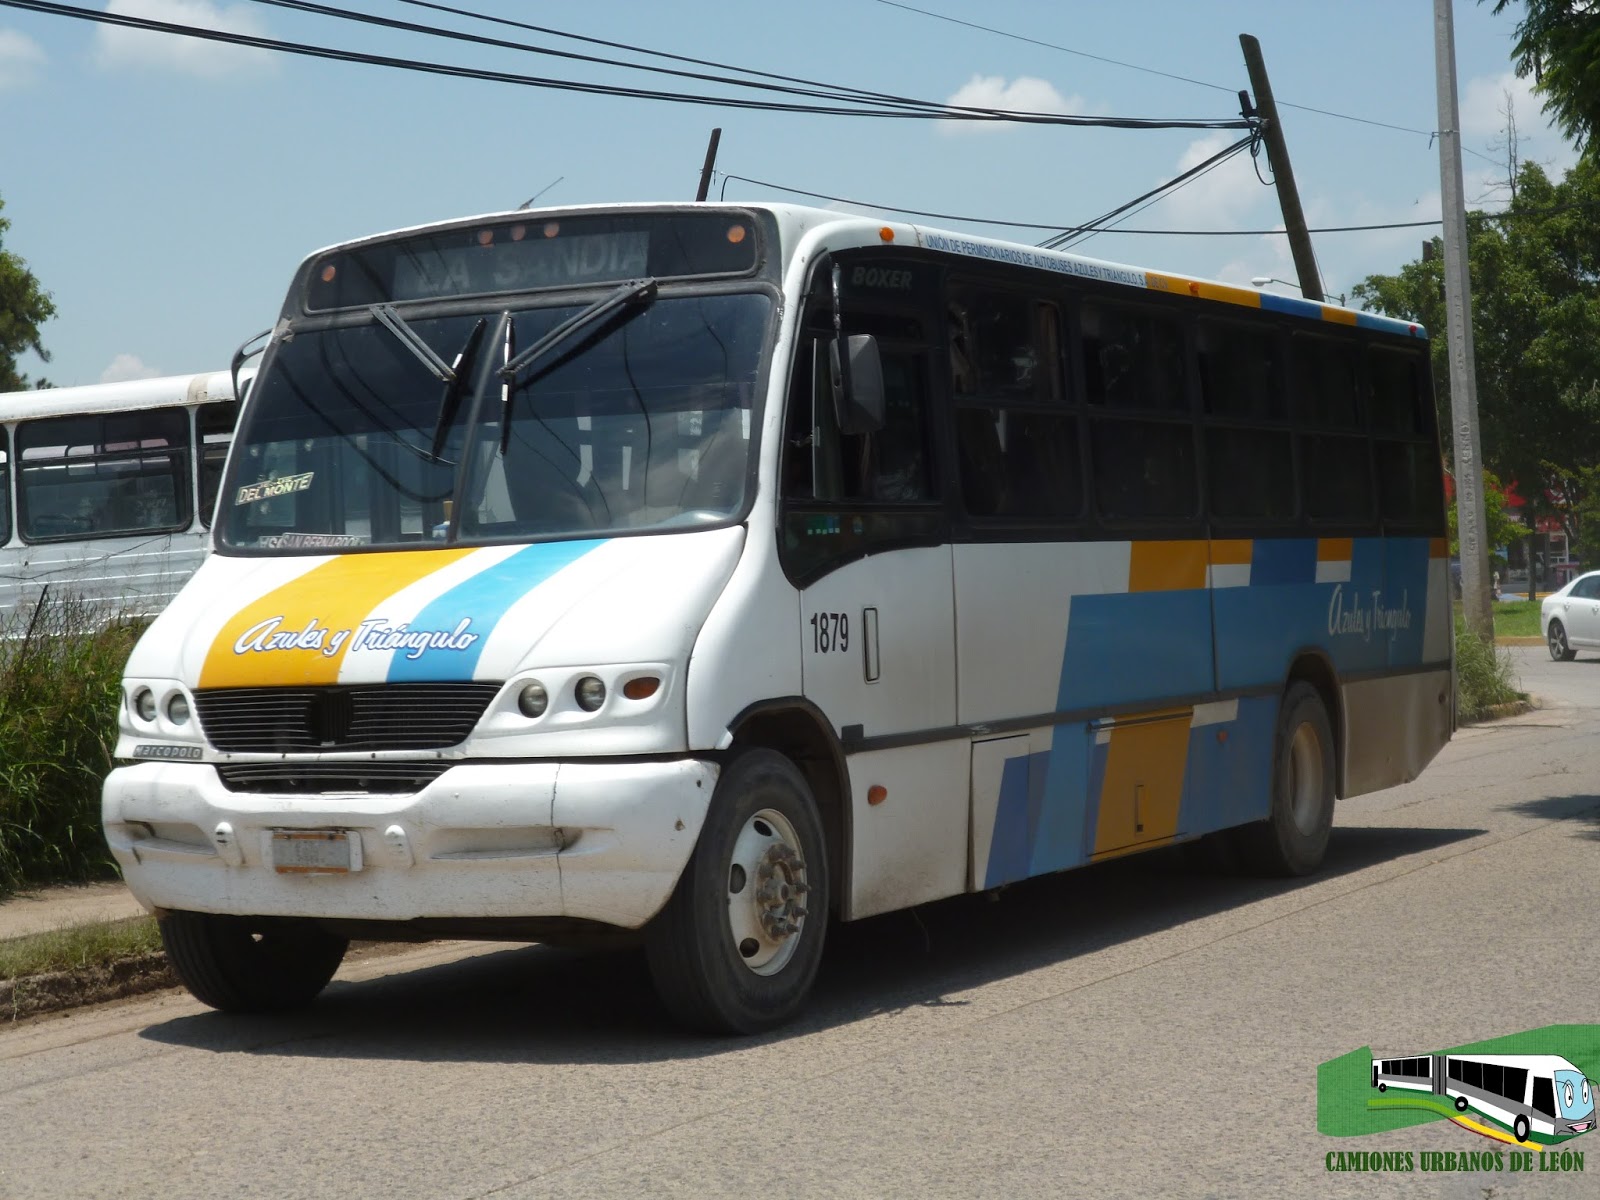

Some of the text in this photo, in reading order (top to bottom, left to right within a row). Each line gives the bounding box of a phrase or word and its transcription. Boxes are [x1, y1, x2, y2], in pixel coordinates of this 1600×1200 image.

[416, 235, 648, 293] LA SANDIA
[851, 266, 912, 291] BOXER
[950, 239, 960, 253] DE
[961, 241, 1022, 263] PERMISIONARIOS
[1022, 252, 1033, 265] DE
[1034, 254, 1073, 273] AUTOBUSES
[1074, 262, 1098, 278] AZULES
[239, 488, 261, 502] DEL
[264, 474, 311, 497] MONTE
[1328, 583, 1365, 636] Azules
[234, 616, 478, 659] Azules y Triángulo
[811, 612, 849, 653] 1879
